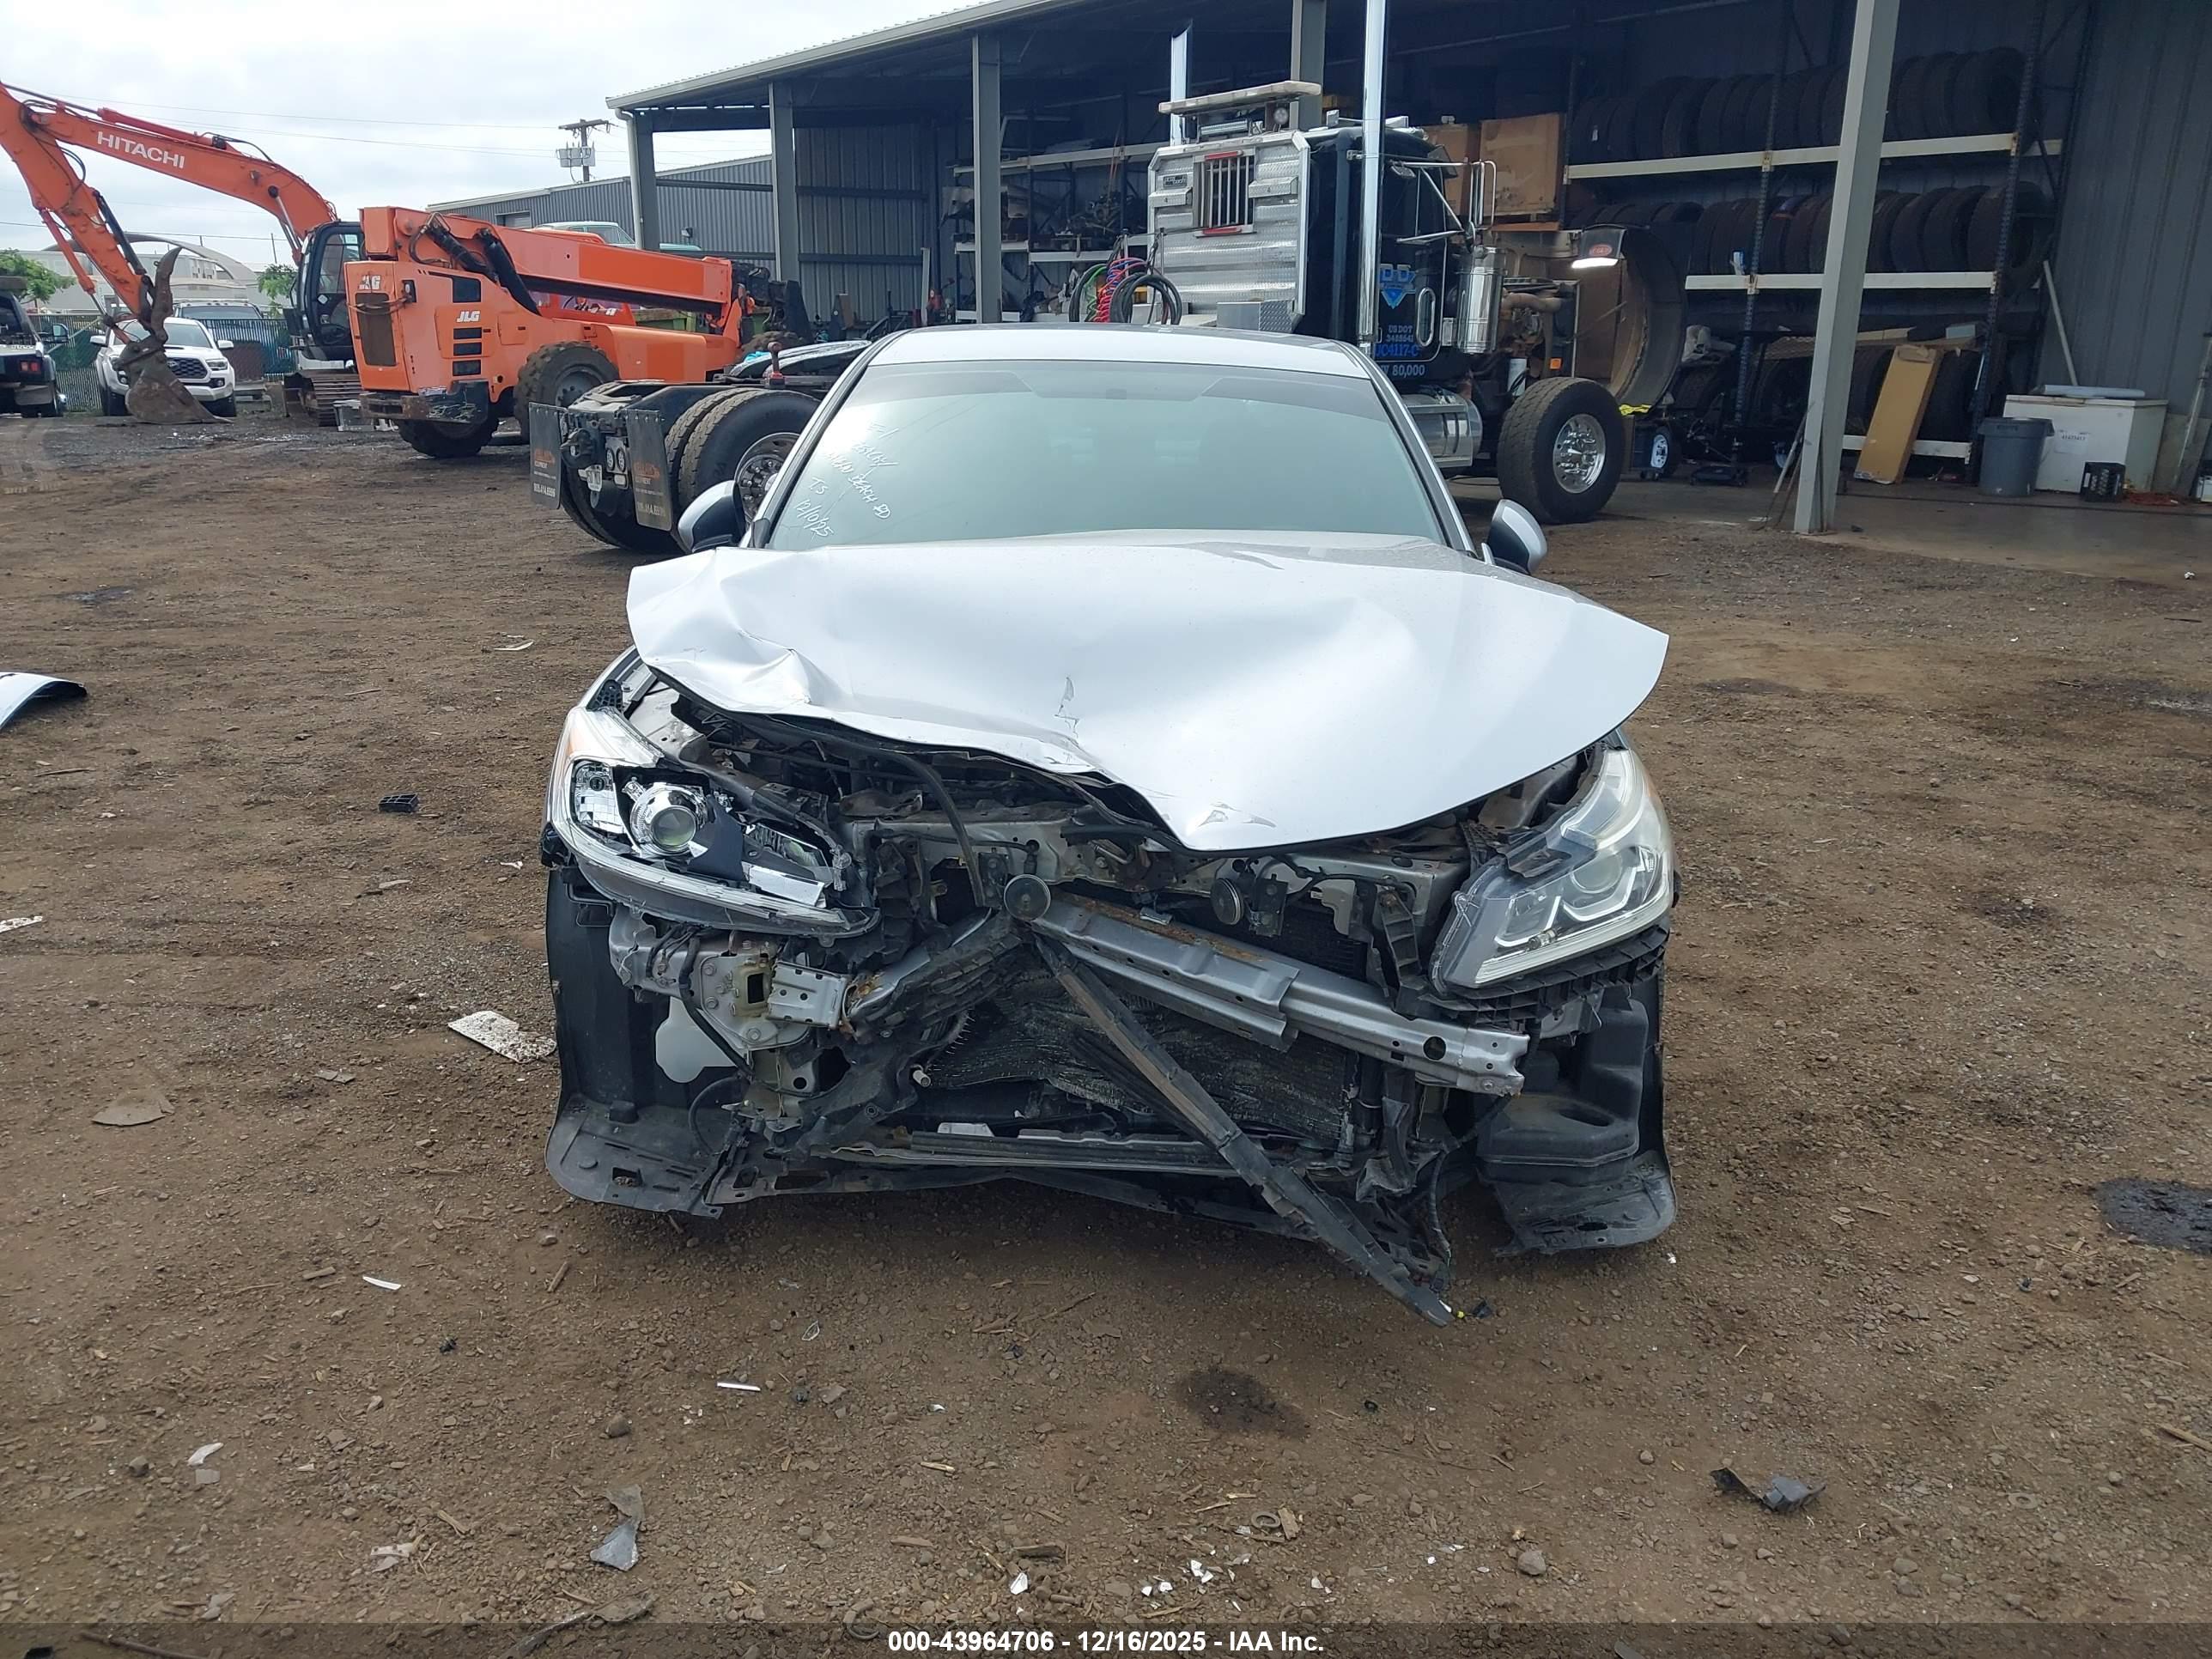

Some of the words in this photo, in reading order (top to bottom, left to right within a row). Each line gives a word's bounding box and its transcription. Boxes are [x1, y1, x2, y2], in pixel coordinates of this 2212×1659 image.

[97, 131, 185, 169] HITACHI
[456, 310, 481, 323] JLG
[1392, 364, 1425, 378] 80,000
[793, 499, 835, 537] 12/10/25
